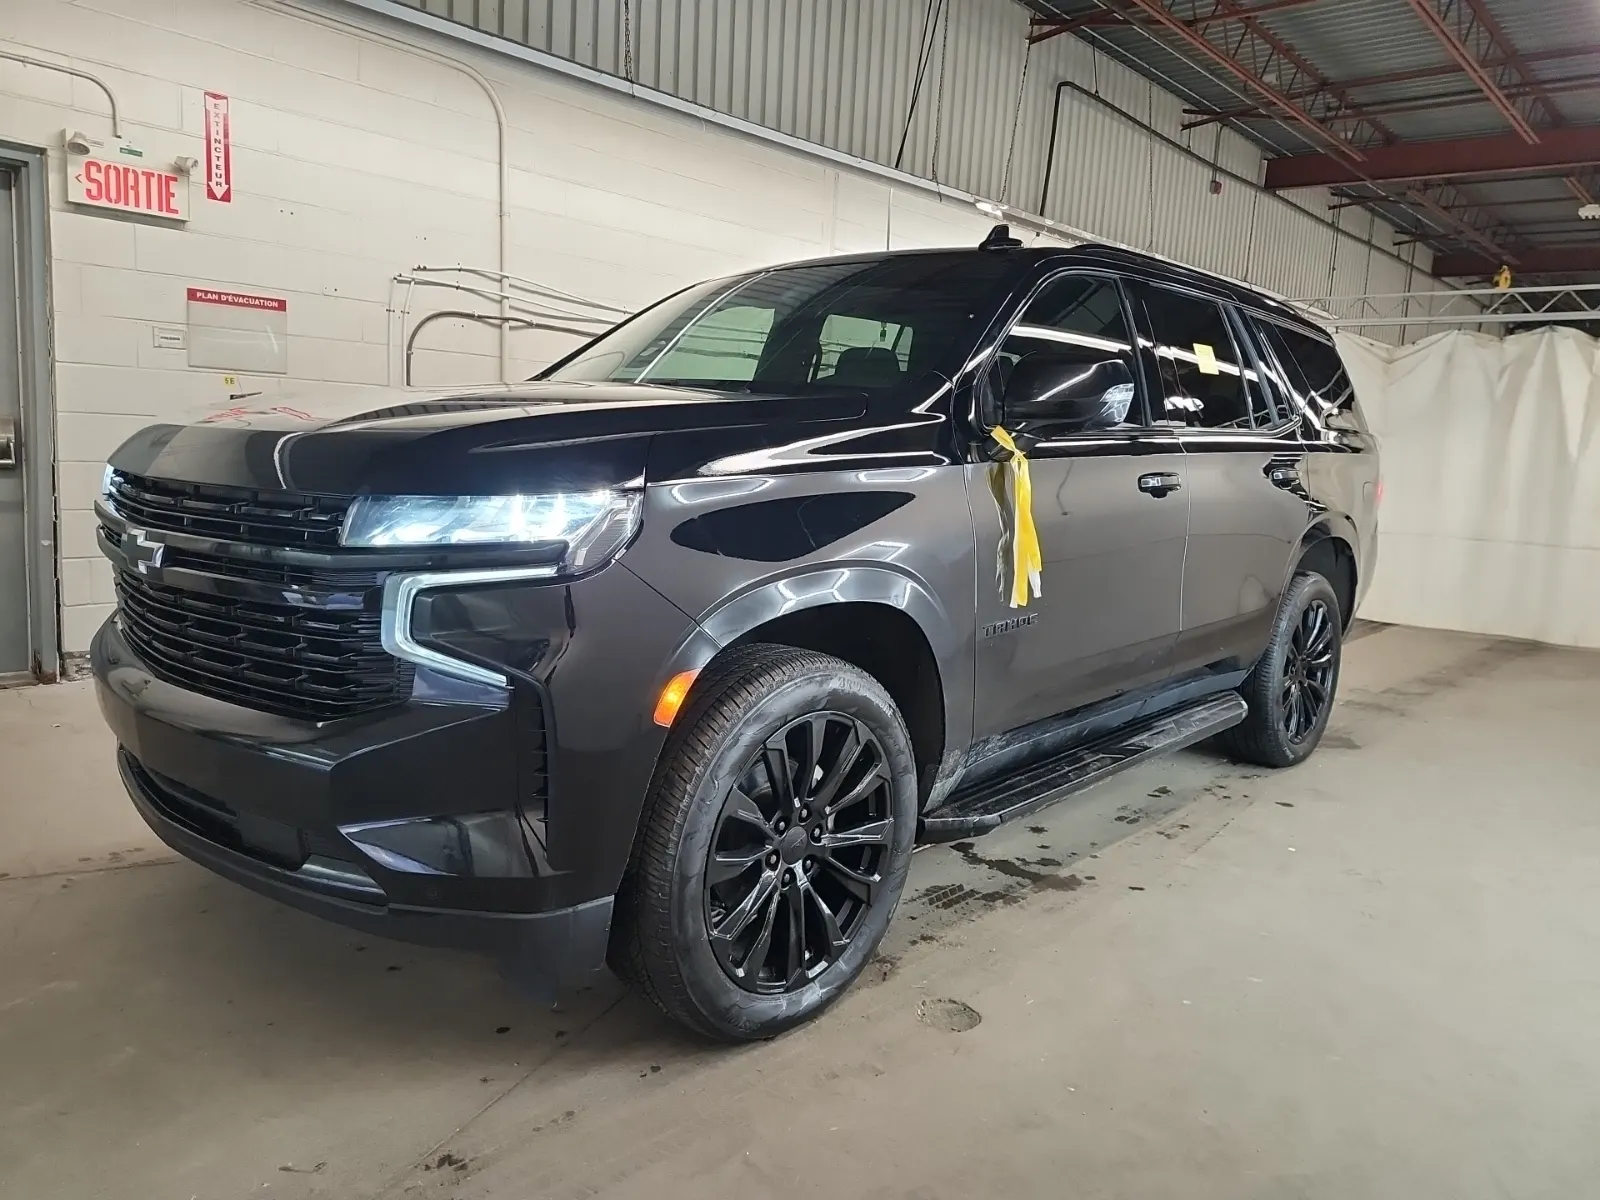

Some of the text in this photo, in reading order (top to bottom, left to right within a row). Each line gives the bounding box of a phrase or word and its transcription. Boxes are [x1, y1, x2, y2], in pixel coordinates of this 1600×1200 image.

[213, 103, 223, 188] EXTINCTEUR
[84, 160, 180, 215] SORTIE
[196, 291, 279, 308] PLAN D'ÉVACUATION
[982, 612, 1039, 638] TAHOE
